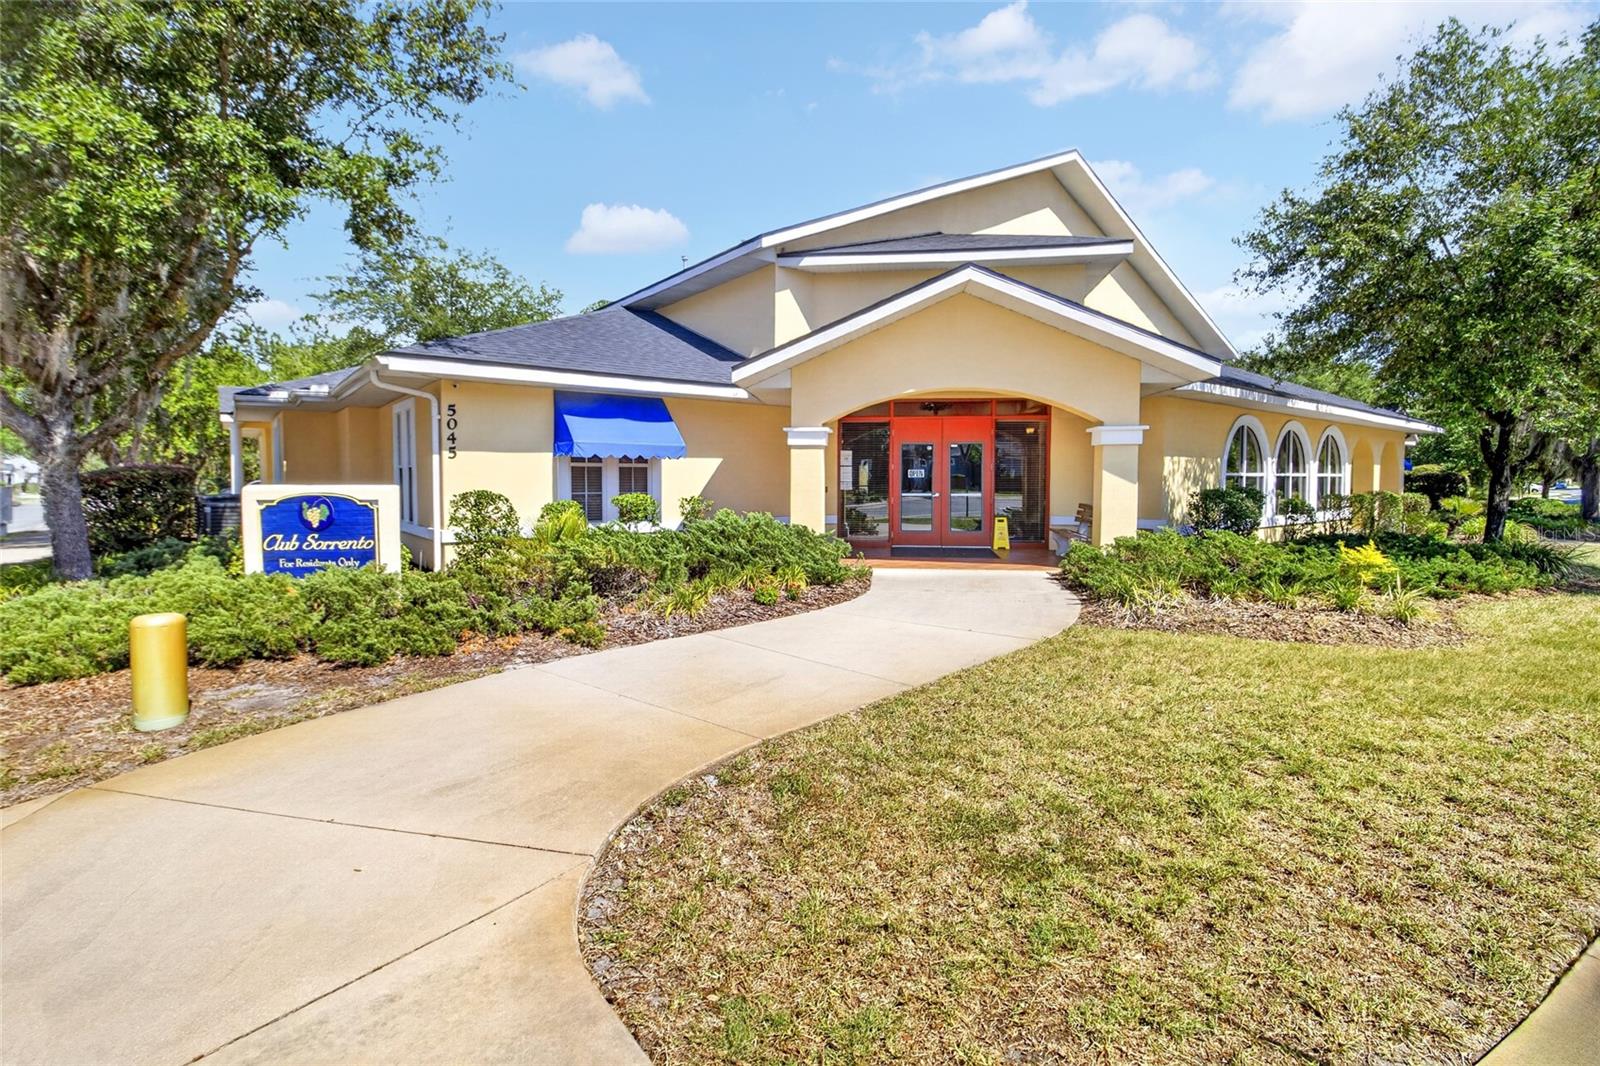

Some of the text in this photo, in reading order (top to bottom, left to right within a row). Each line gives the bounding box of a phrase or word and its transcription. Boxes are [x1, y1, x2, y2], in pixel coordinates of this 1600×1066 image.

[447, 404, 457, 459] 5045
[263, 534, 374, 551] Club Sorrento
[279, 559, 294, 568] For
[338, 557, 360, 567] Only
